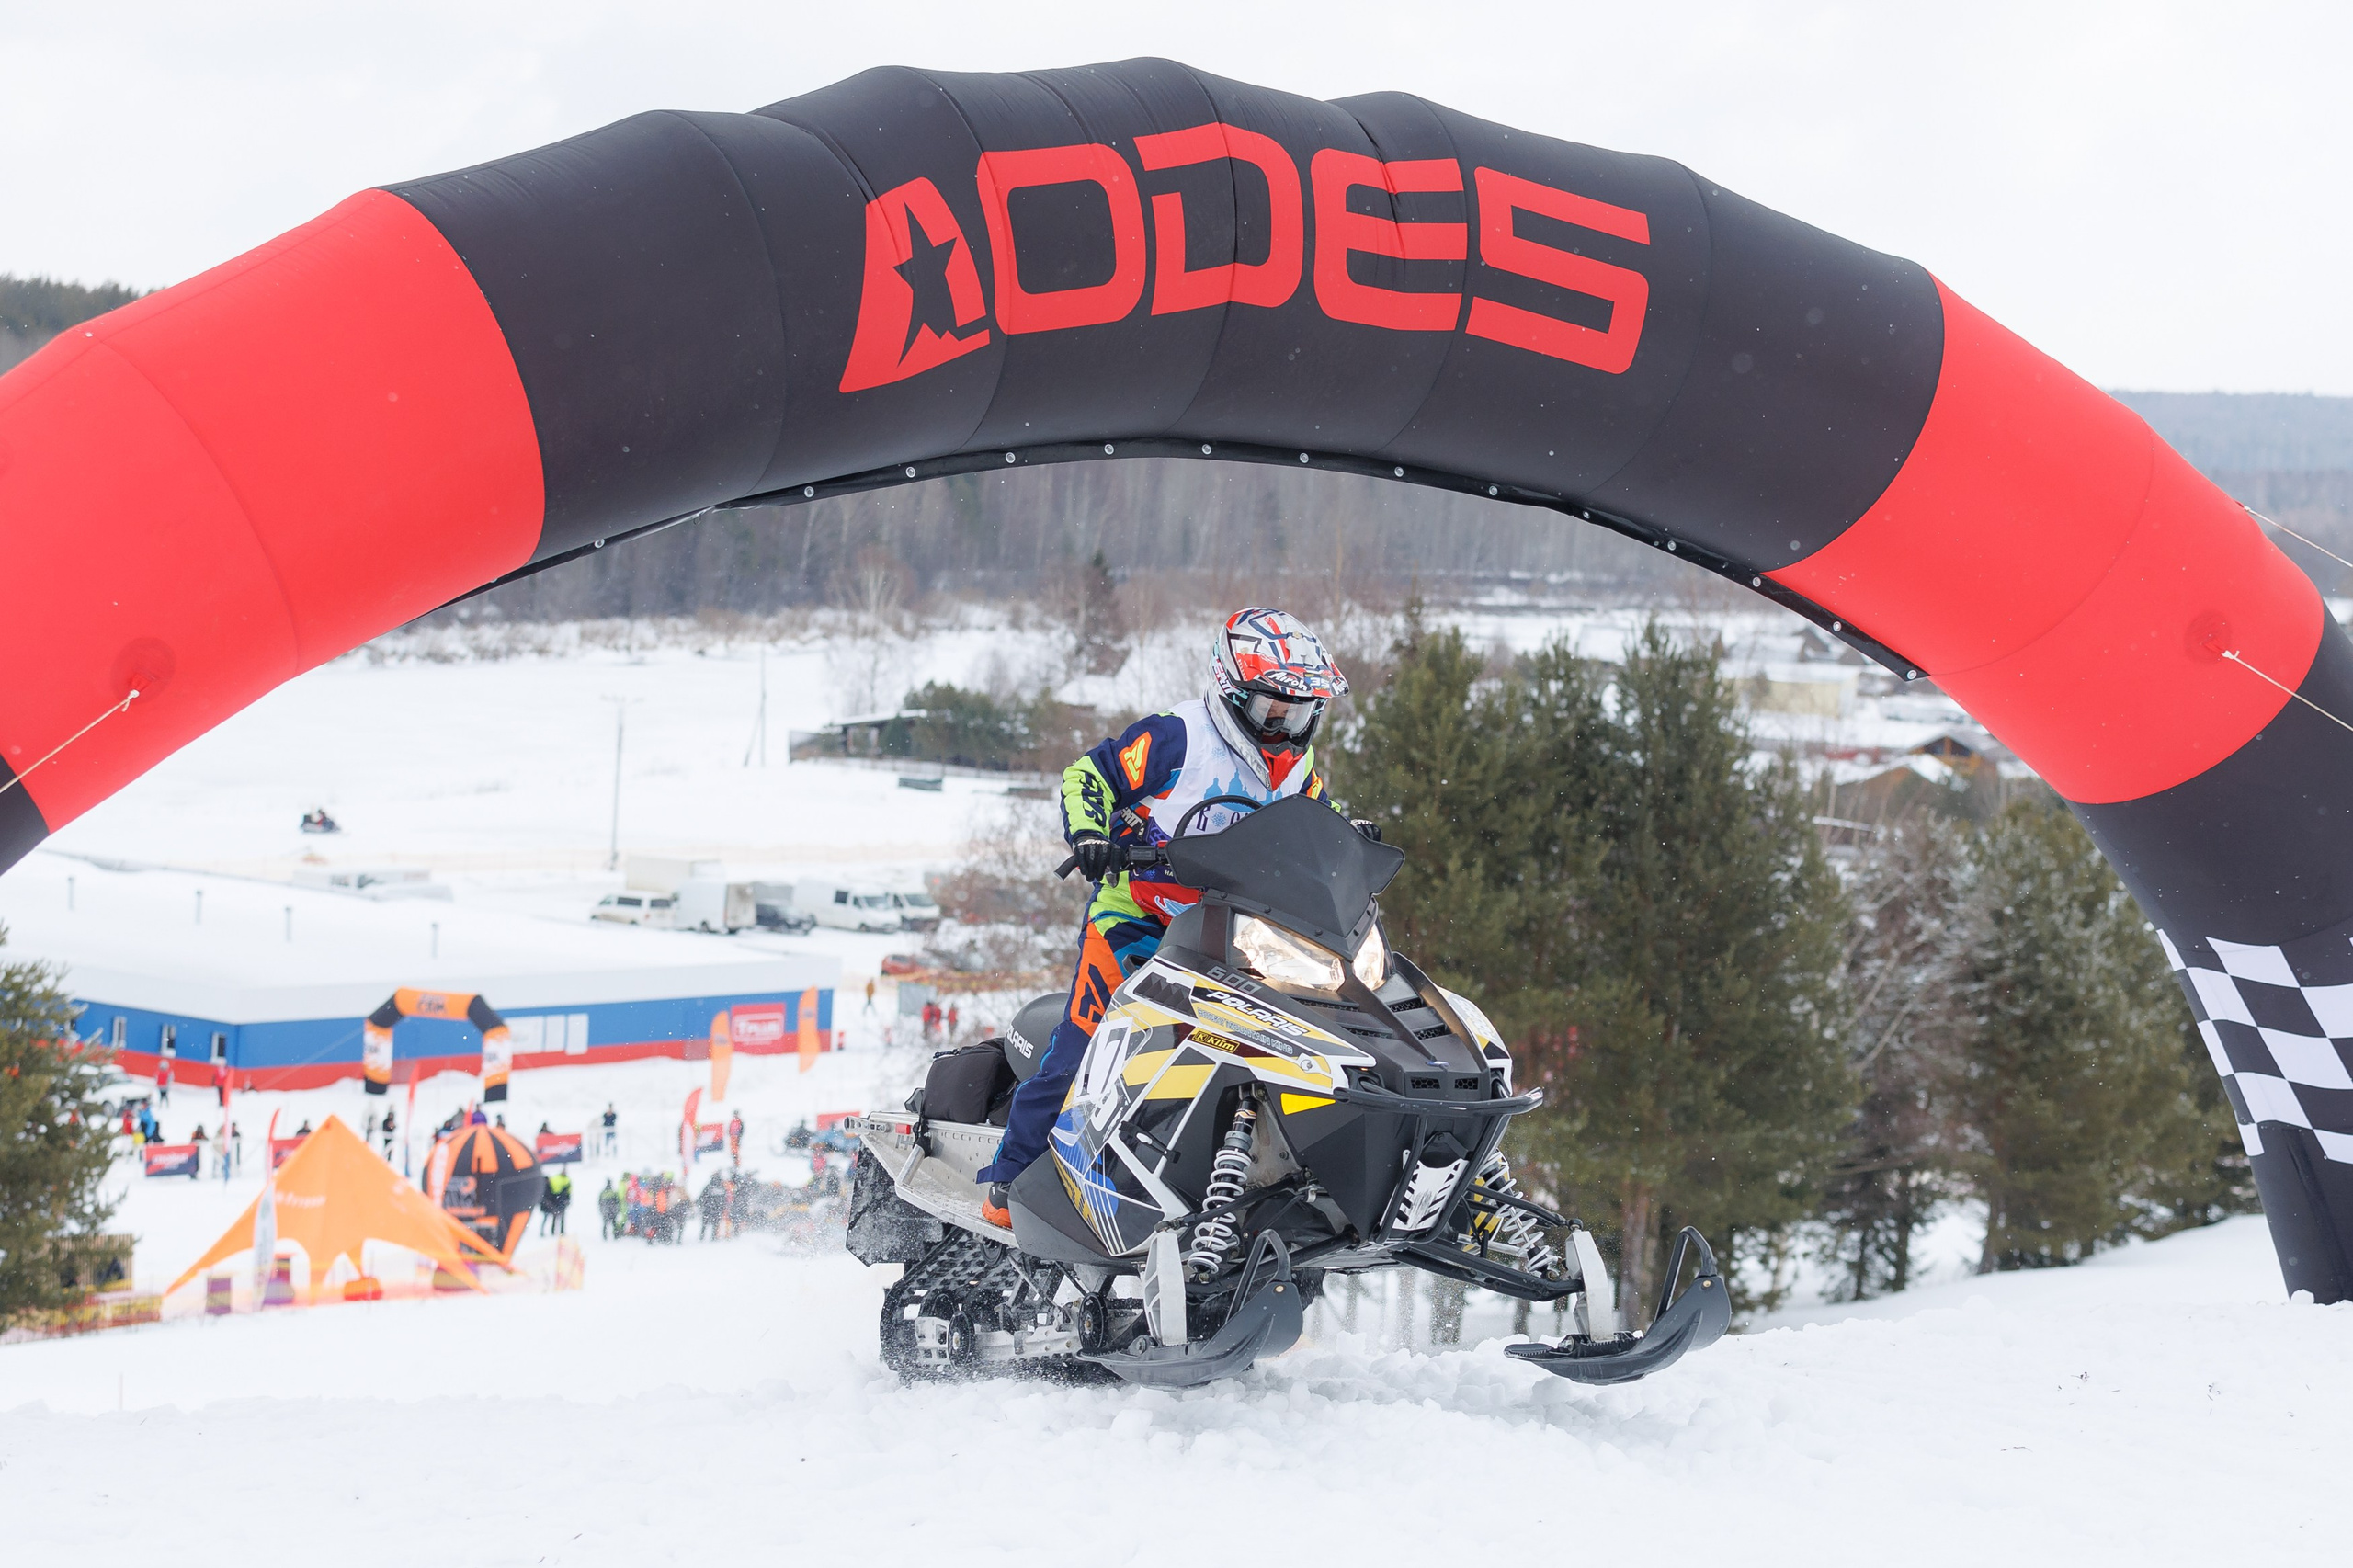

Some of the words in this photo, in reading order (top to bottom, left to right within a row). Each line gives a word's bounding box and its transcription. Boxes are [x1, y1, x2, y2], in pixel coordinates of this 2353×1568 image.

[838, 121, 1651, 394] AODES
[1268, 672, 1308, 691] Airoh
[1207, 966, 1262, 995] 600
[1206, 991, 1309, 1037] POLARIS
[1006, 1027, 1035, 1060] OLARIS
